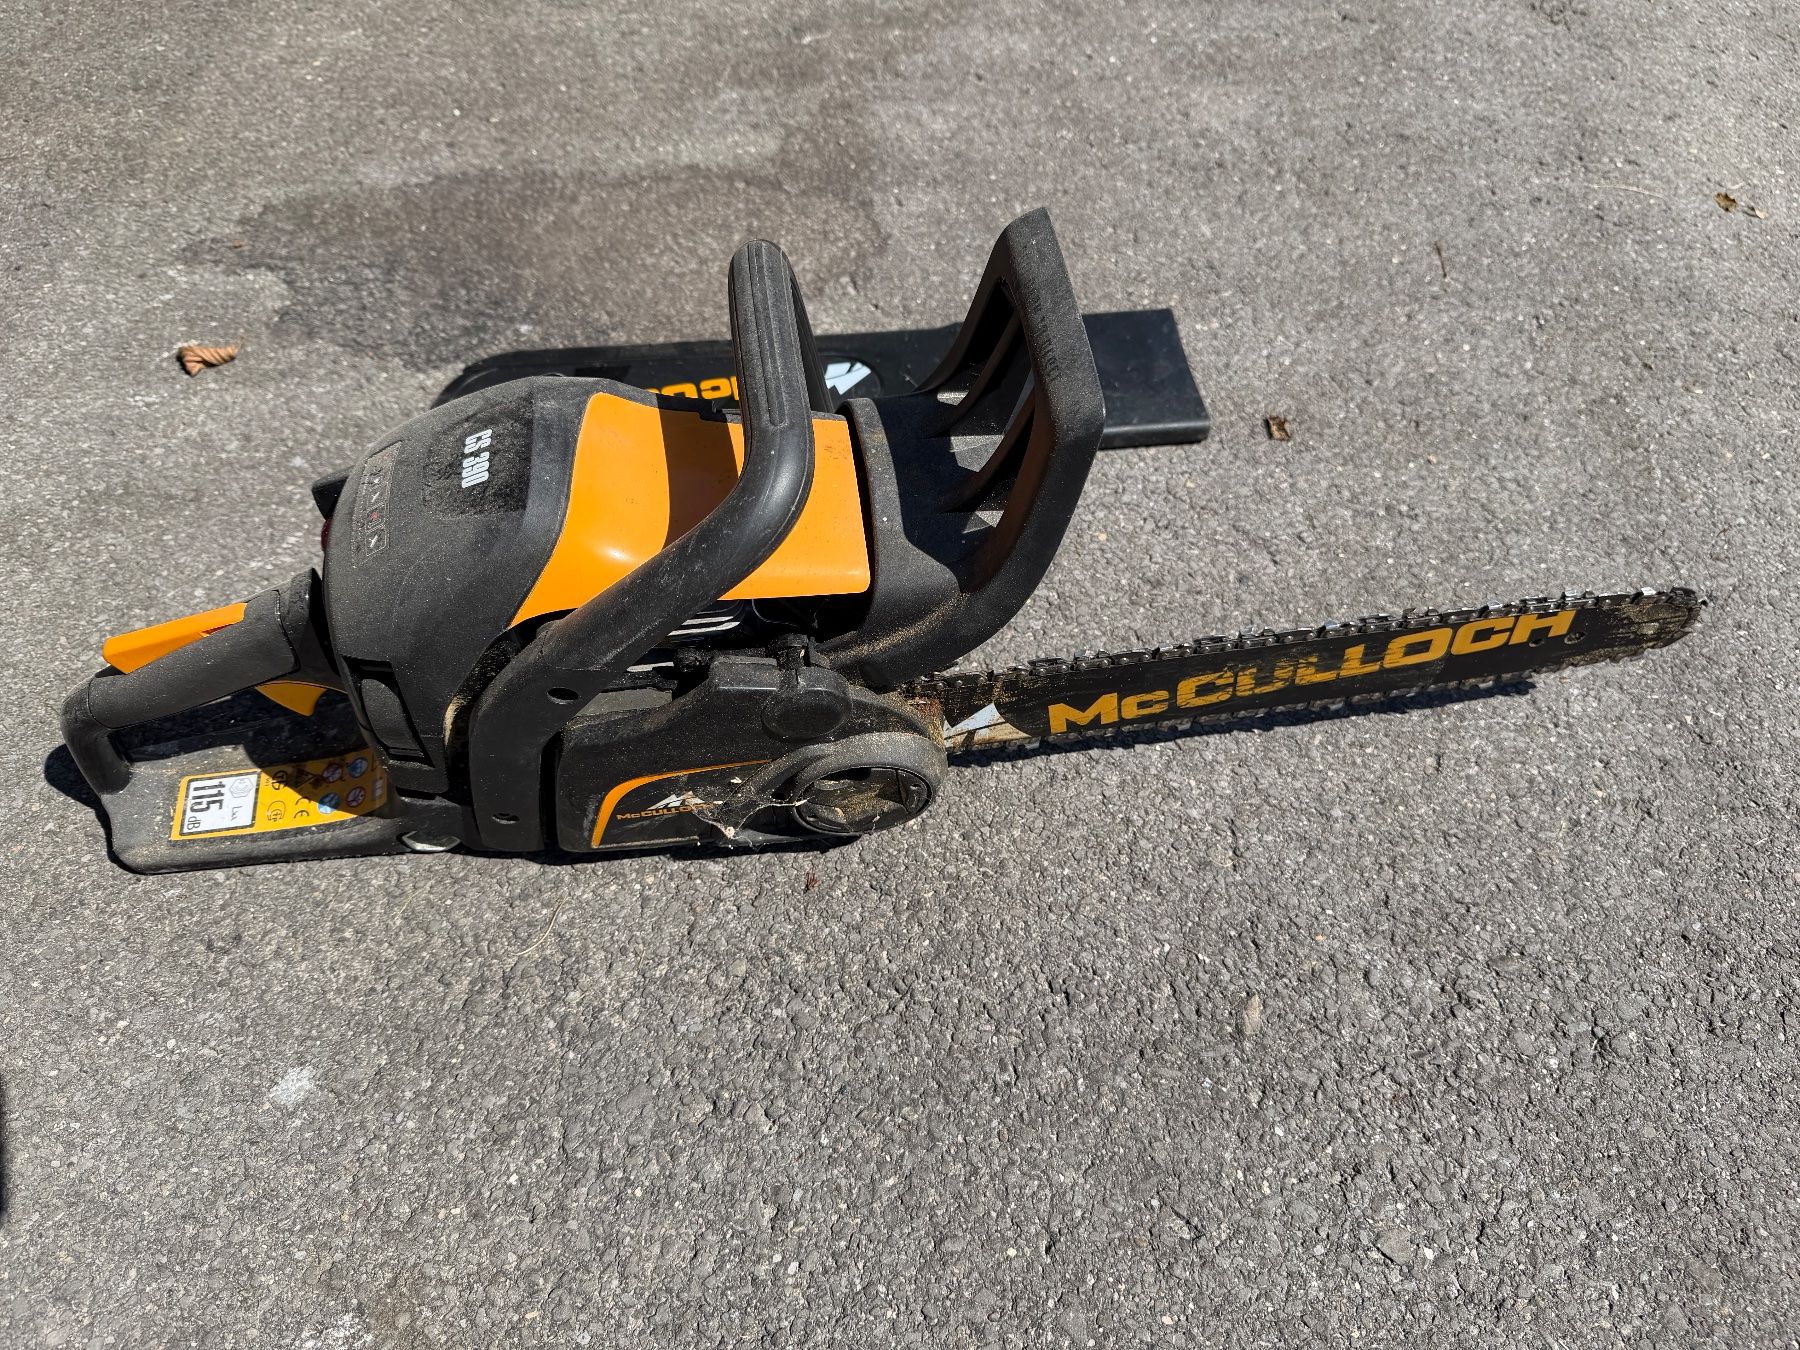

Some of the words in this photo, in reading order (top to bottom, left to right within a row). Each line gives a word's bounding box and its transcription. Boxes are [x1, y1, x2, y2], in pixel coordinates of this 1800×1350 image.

[464, 428, 493, 454] CS
[461, 451, 490, 489] 390
[1048, 610, 1577, 735] McCULLOCH
[190, 781, 225, 813] 115
[616, 802, 716, 820] McCULLO
[186, 816, 201, 830] dB
